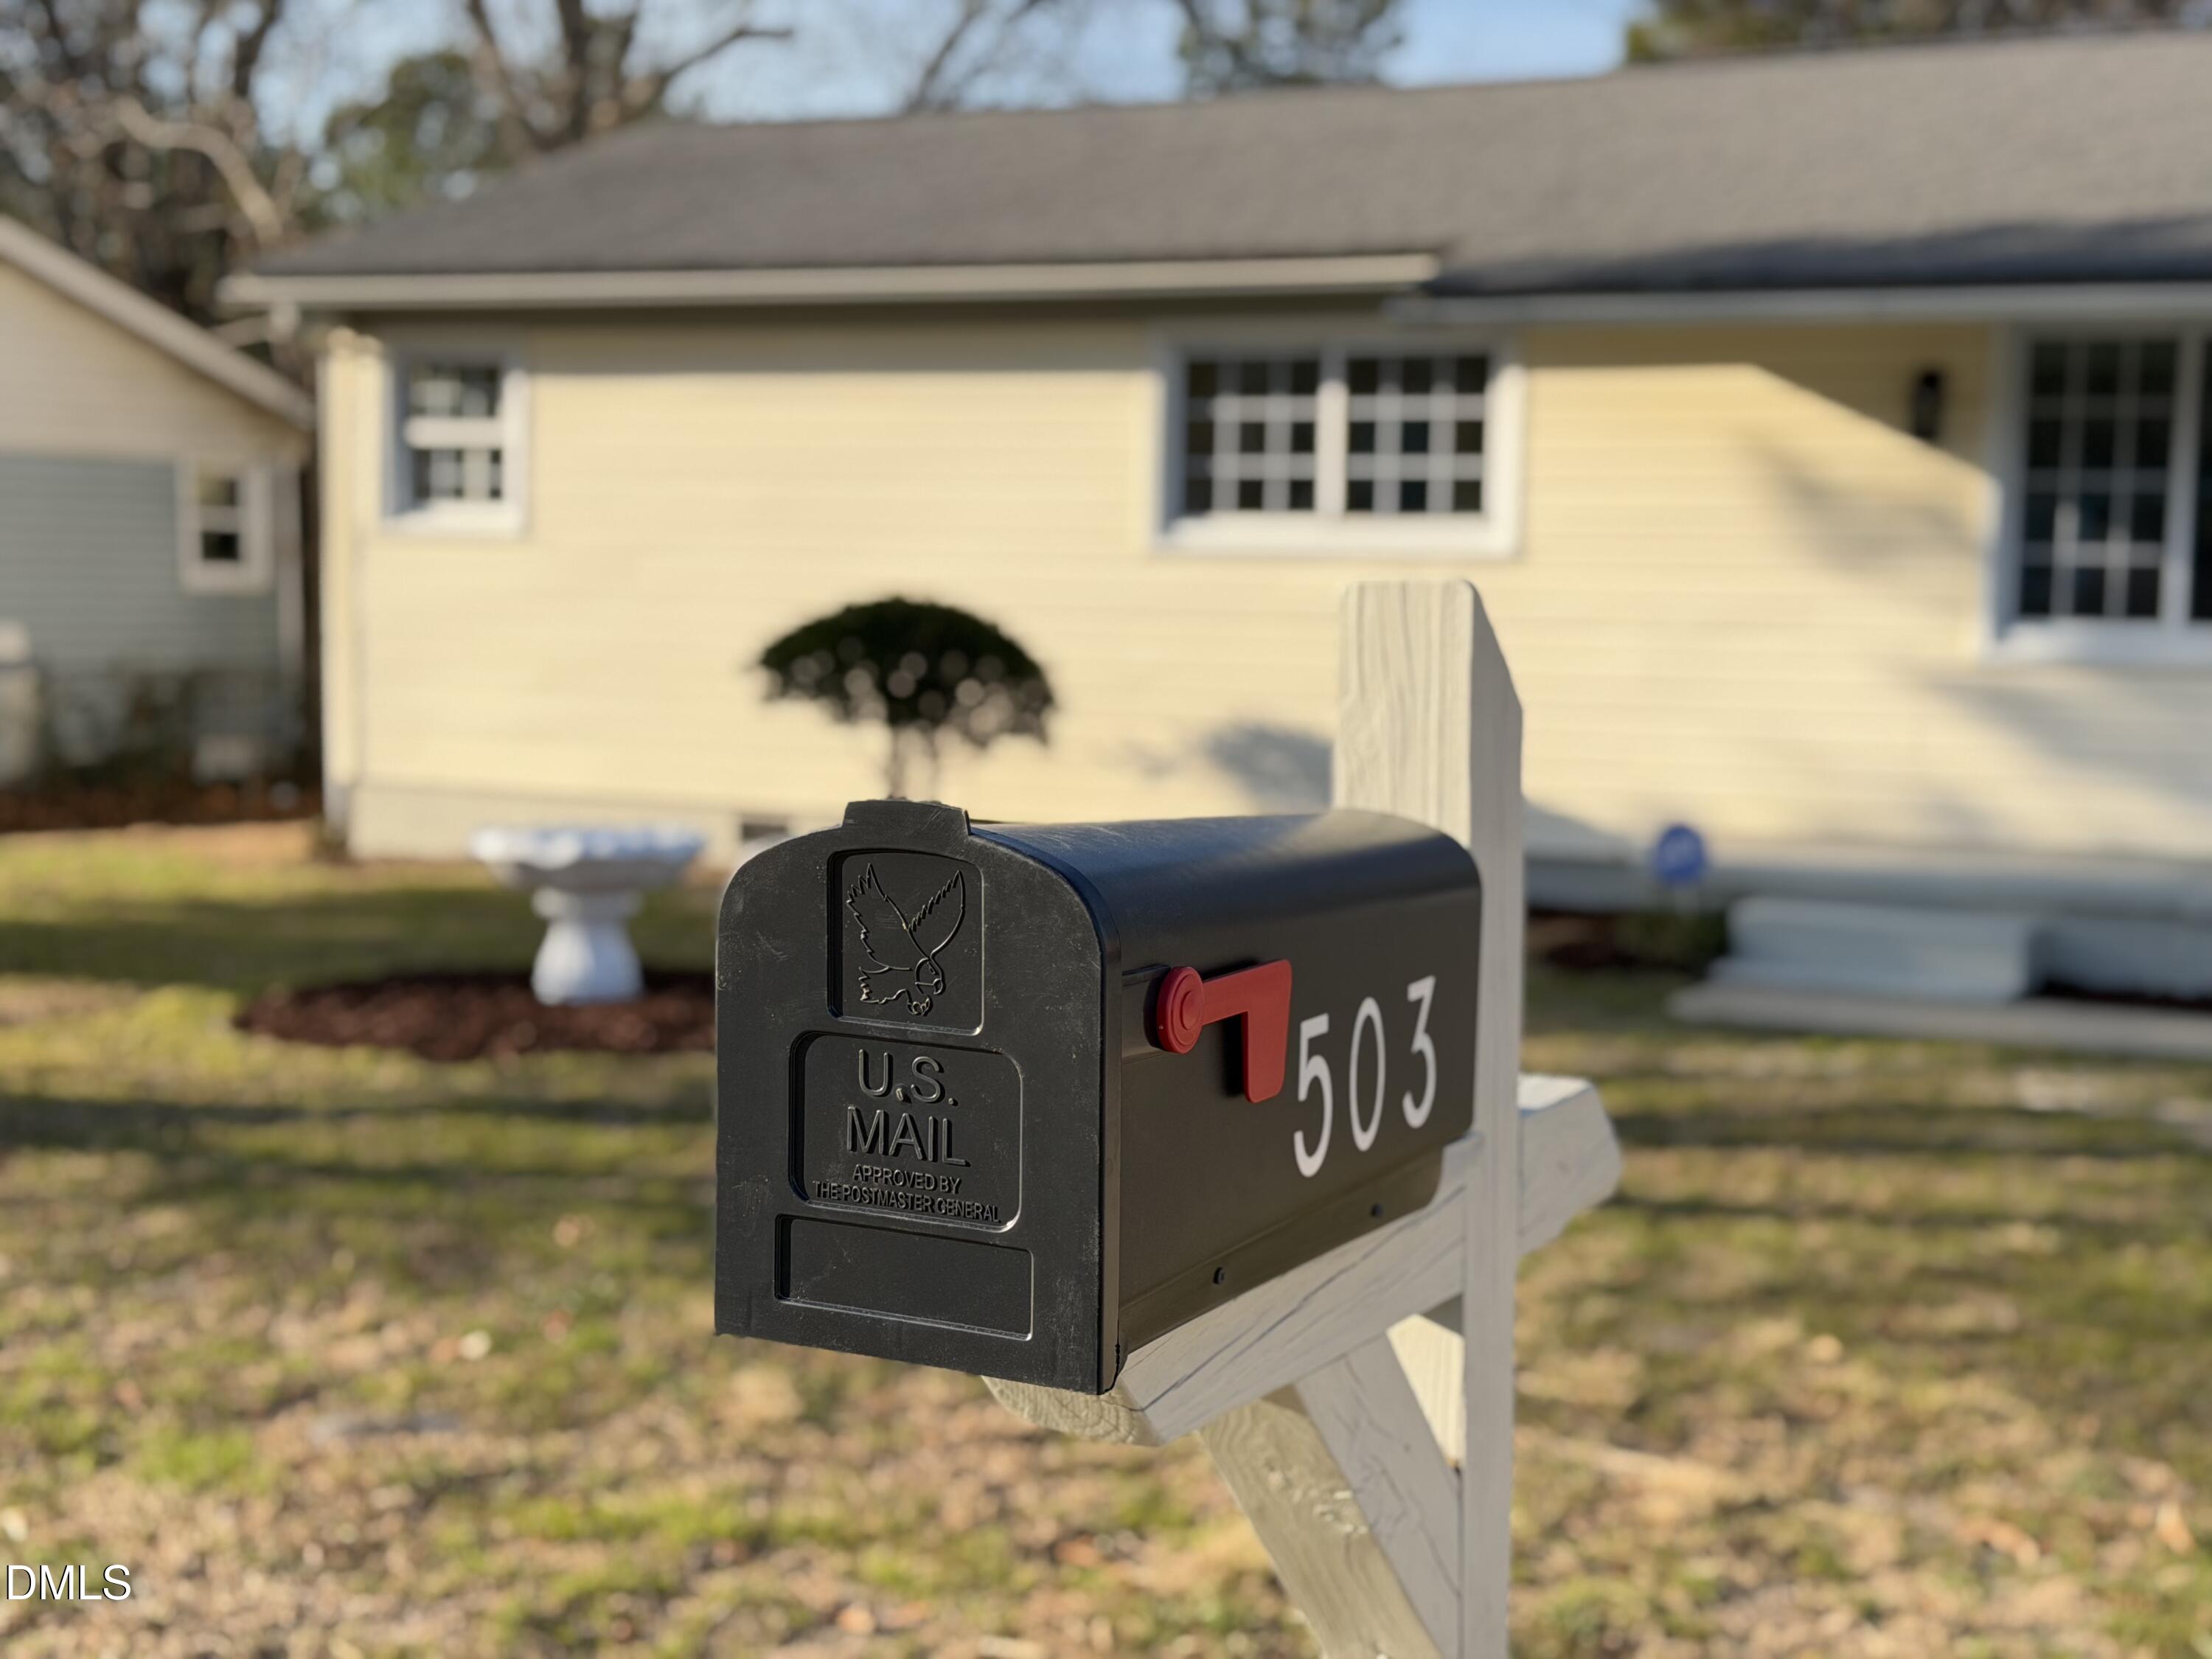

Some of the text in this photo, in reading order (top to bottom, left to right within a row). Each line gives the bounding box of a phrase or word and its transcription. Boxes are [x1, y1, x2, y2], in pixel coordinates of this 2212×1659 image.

[858, 1048, 957, 1105] U.S.
[1293, 975, 1437, 1178] 503
[847, 1105, 970, 1166] MAIL
[813, 1180, 1001, 1222] THE POSTMASTER GENERAL
[852, 1164, 961, 1194] APPROVED BY
